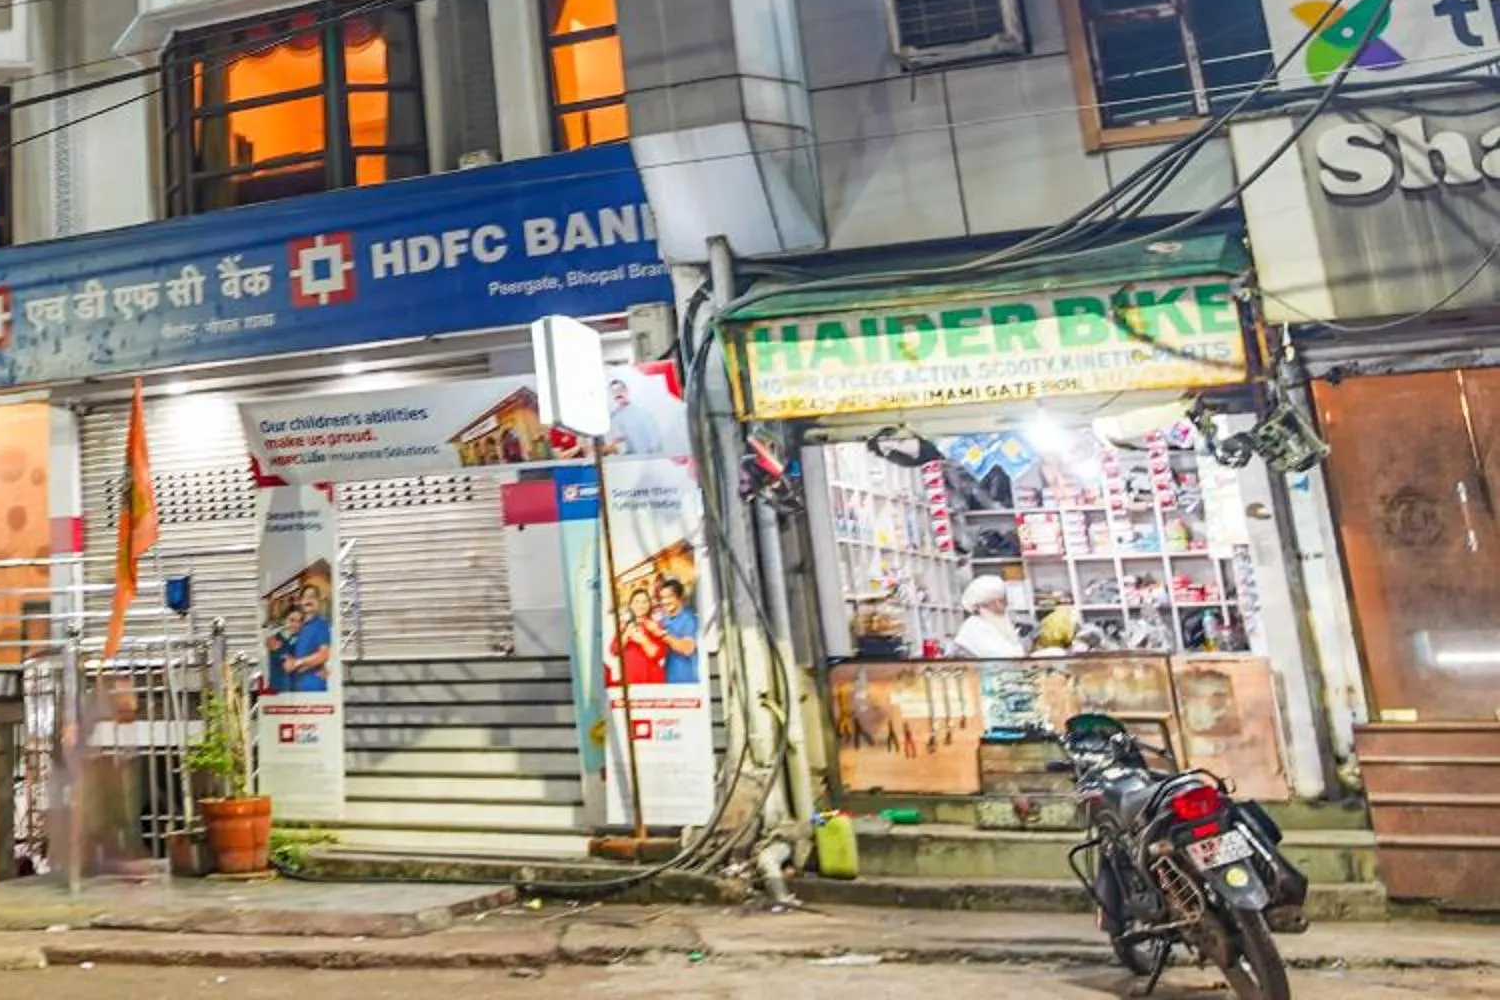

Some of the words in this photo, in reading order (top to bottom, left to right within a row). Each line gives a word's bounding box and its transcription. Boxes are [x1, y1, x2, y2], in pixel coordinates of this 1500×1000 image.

[370, 225, 507, 279] HDFC
[566, 262, 625, 289] Bhopal
[752, 303, 1041, 372] HAIDER
[1054, 283, 1238, 347] BIKE
[986, 381, 1037, 397] GATE
[260, 419, 286, 433] Our
[289, 412, 362, 431] children's
[365, 407, 429, 425] abilities
[264, 435, 304, 449] make
